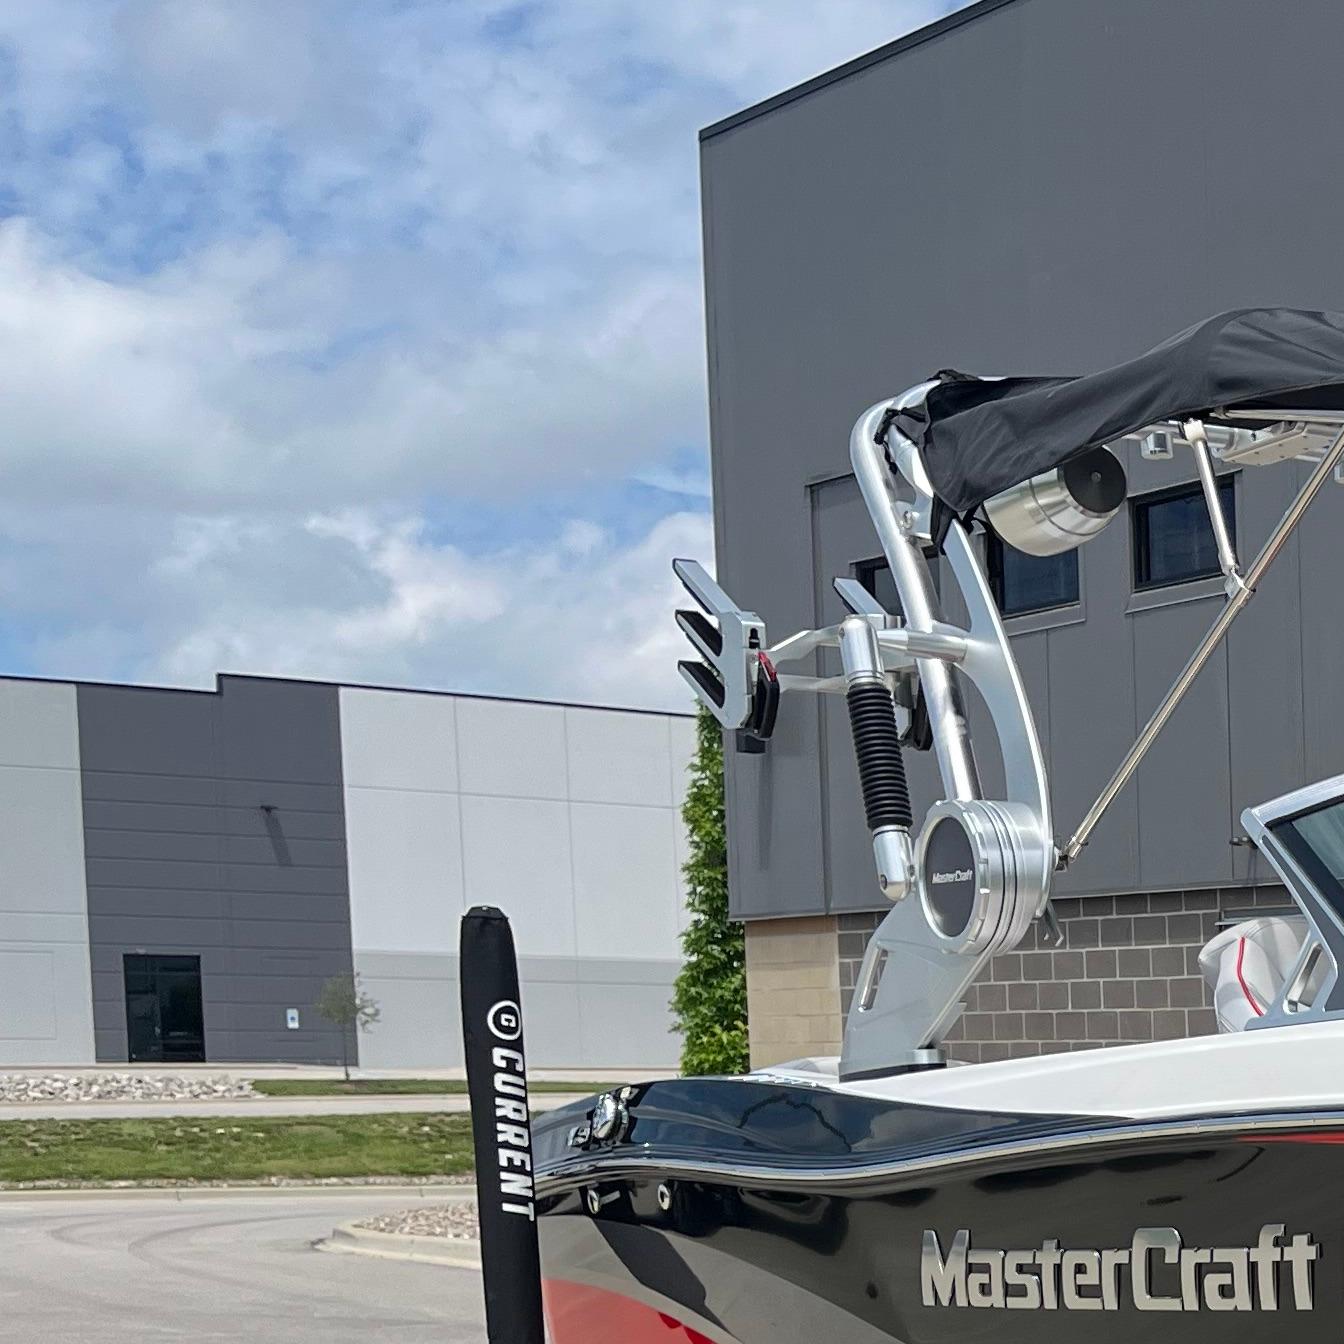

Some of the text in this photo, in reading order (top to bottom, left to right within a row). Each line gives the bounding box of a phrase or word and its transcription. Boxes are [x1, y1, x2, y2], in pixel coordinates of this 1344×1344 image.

[931, 868, 974, 885] MasterCraft
[491, 1046, 535, 1222] CURRENT
[920, 1223, 1323, 1311] MasterCraft
